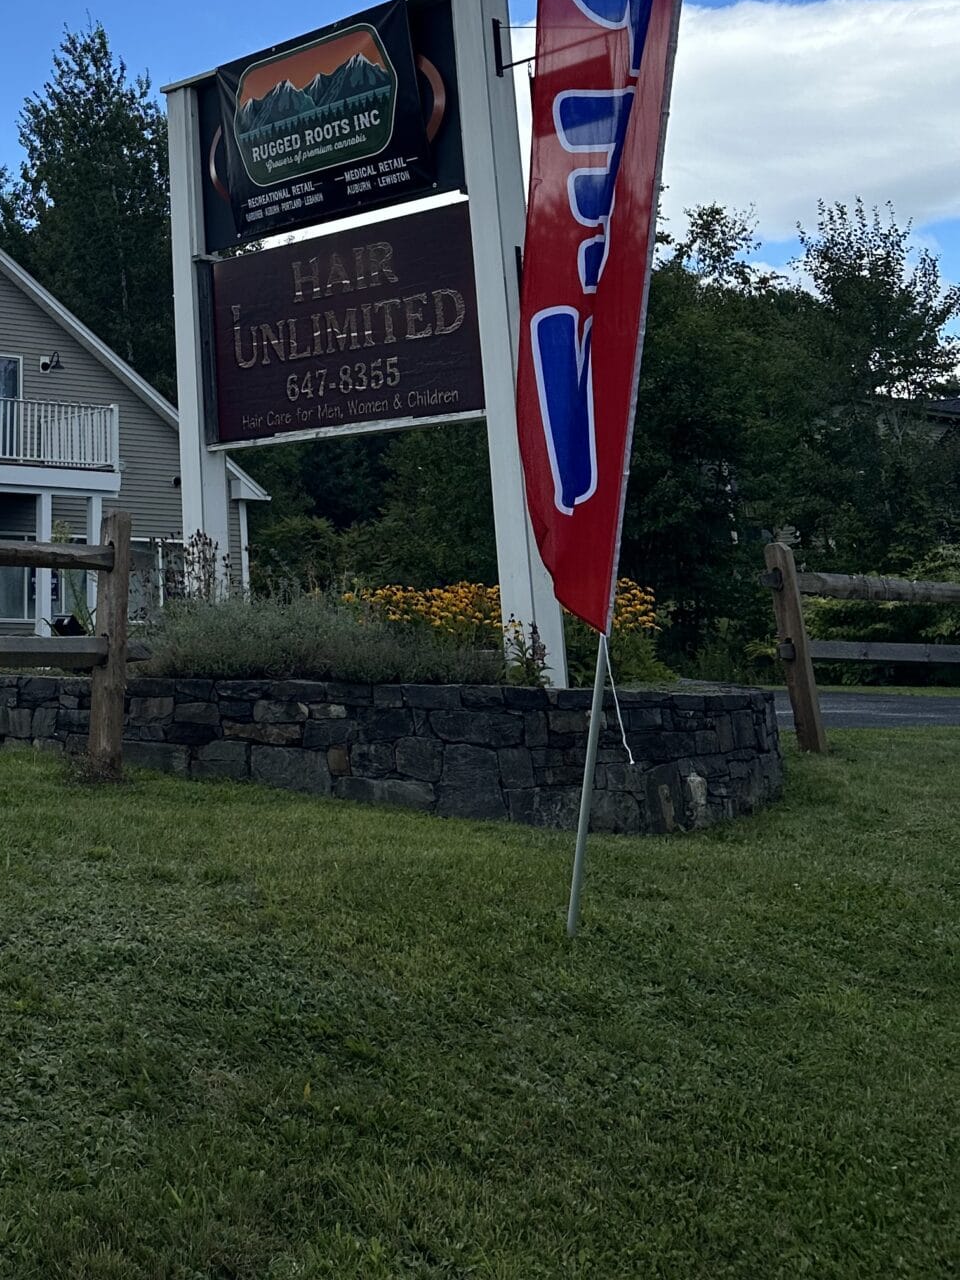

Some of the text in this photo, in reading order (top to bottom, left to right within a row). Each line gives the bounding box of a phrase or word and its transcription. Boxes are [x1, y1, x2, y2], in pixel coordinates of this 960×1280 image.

[252, 109, 381, 163] RUGGED ROOTS INC
[265, 134, 367, 174] Growers of premium cannabis
[344, 156, 407, 183] MEDICAL RETAIL
[346, 170, 411, 195] AUBURN LEWISTON
[247, 181, 316, 209] RECREATIONAL RETAIL
[281, 198, 302, 213] PORTLAND
[292, 241, 399, 303] HAIR
[231, 288, 466, 369] UNLIMITED
[286, 356, 401, 401] 647-8355
[242, 388, 460, 430] Hair Care for Men, Women & Children
